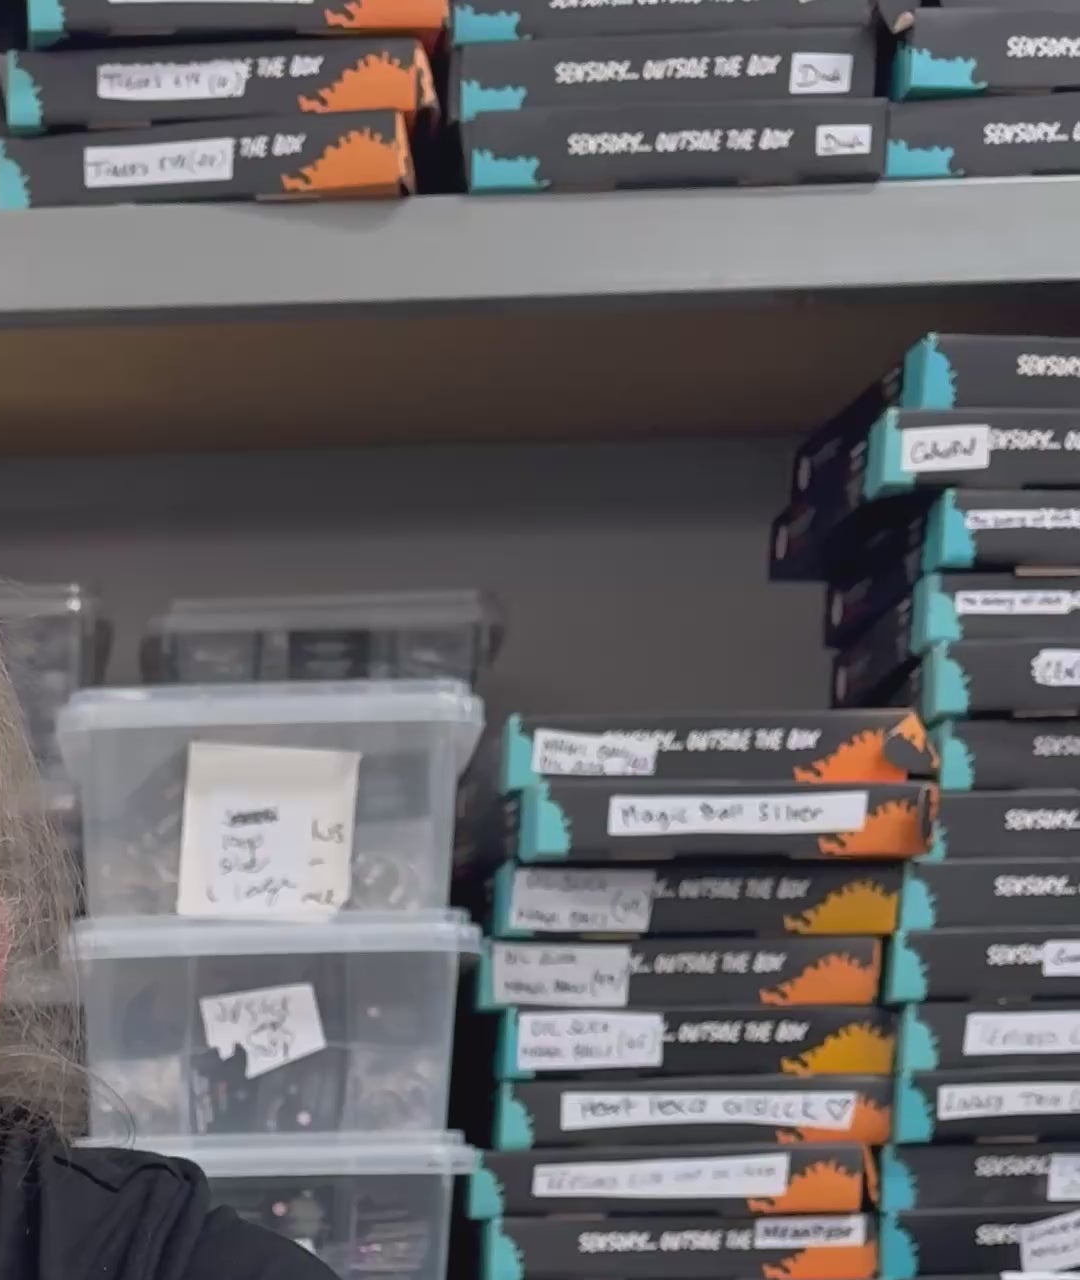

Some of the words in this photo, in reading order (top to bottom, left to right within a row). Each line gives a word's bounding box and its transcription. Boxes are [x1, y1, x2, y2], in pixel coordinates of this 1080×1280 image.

[642, 56, 710, 80] OUTSIDE
[714, 55, 744, 77] THE
[746, 53, 782, 76] BOX
[272, 133, 307, 156] BOX
[655, 129, 723, 152] OUTSIDE
[726, 128, 756, 150] THE
[758, 127, 794, 150] BOX
[755, 728, 785, 750] THE
[787, 728, 822, 749] BOX
[746, 877, 773, 900] THE
[777, 877, 812, 899] BOX
[721, 951, 750, 974] THE
[753, 951, 787, 973] BOX
[744, 1020, 772, 1042] THE
[775, 1019, 809, 1043] BOX
